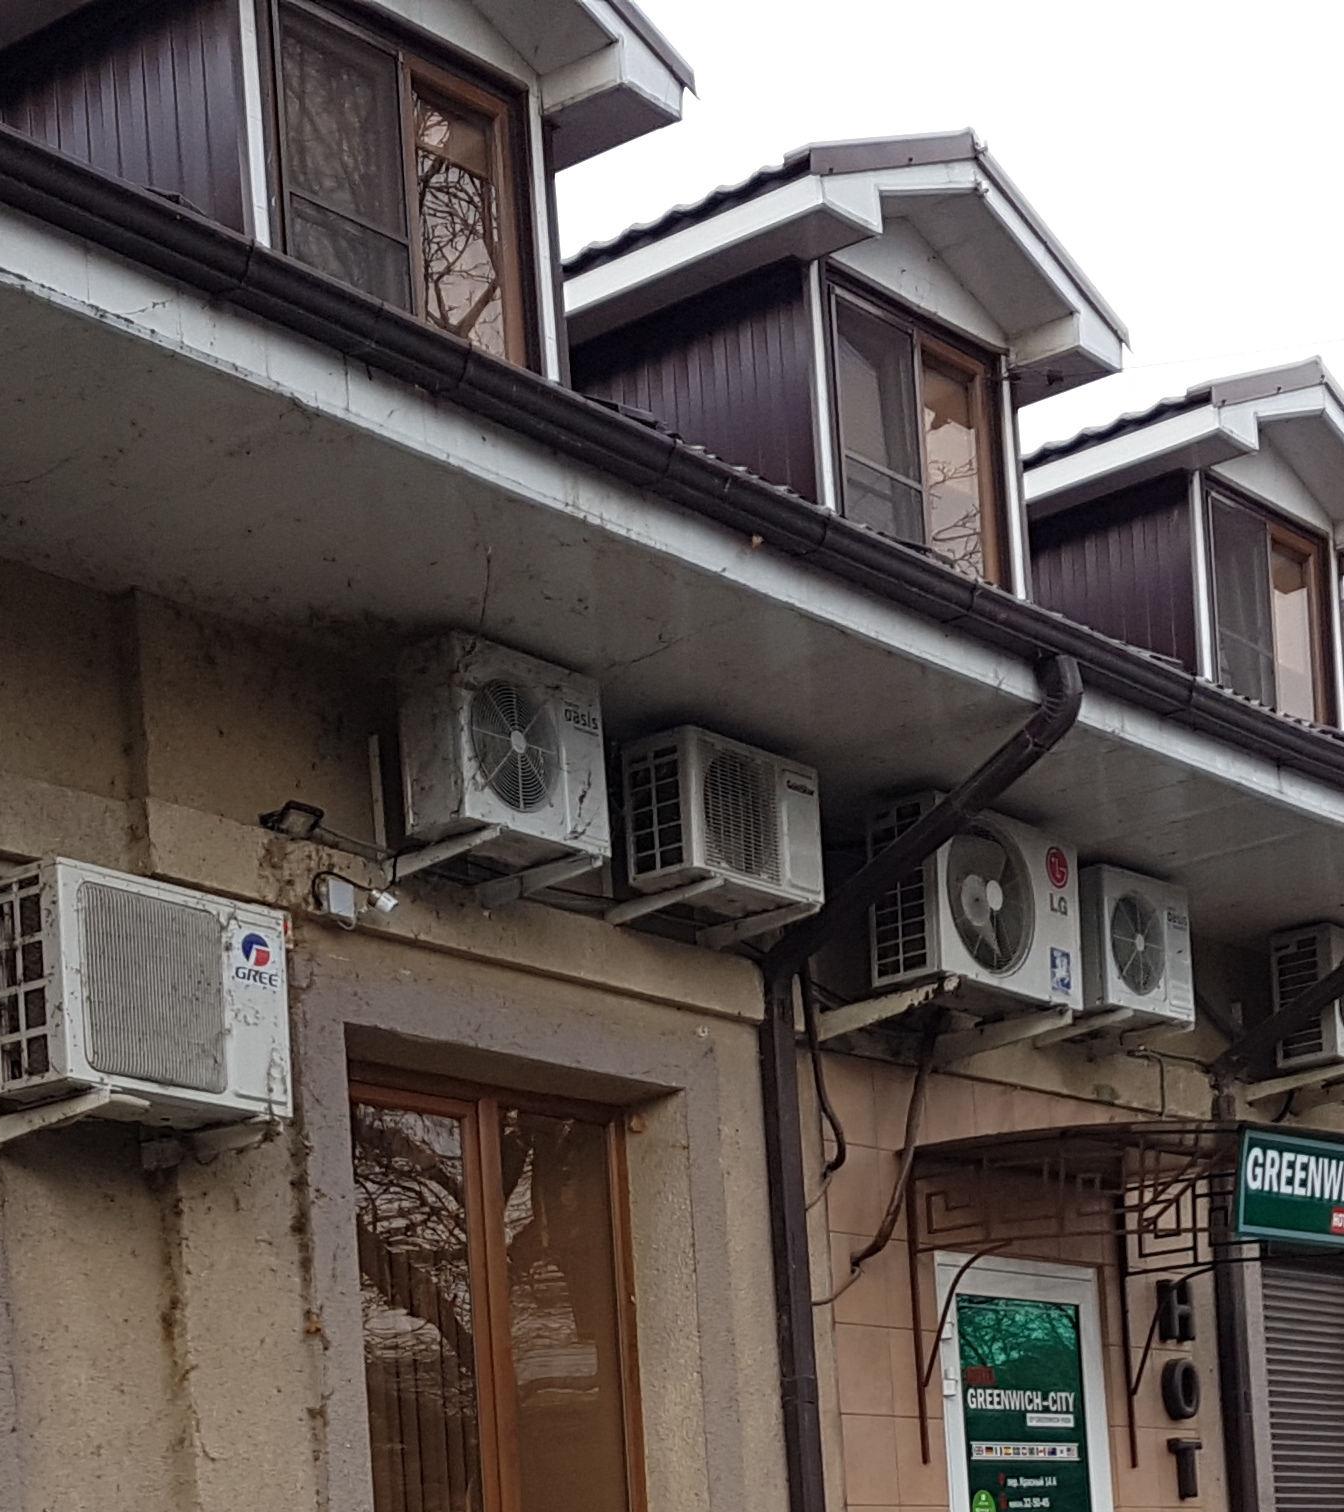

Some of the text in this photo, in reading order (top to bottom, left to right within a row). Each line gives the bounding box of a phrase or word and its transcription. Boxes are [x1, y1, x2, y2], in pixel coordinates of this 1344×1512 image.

[1049, 892, 1068, 917] LG
[235, 966, 280, 988] GREE
[967, 1388, 1075, 1412] GREENWICH-CITY
